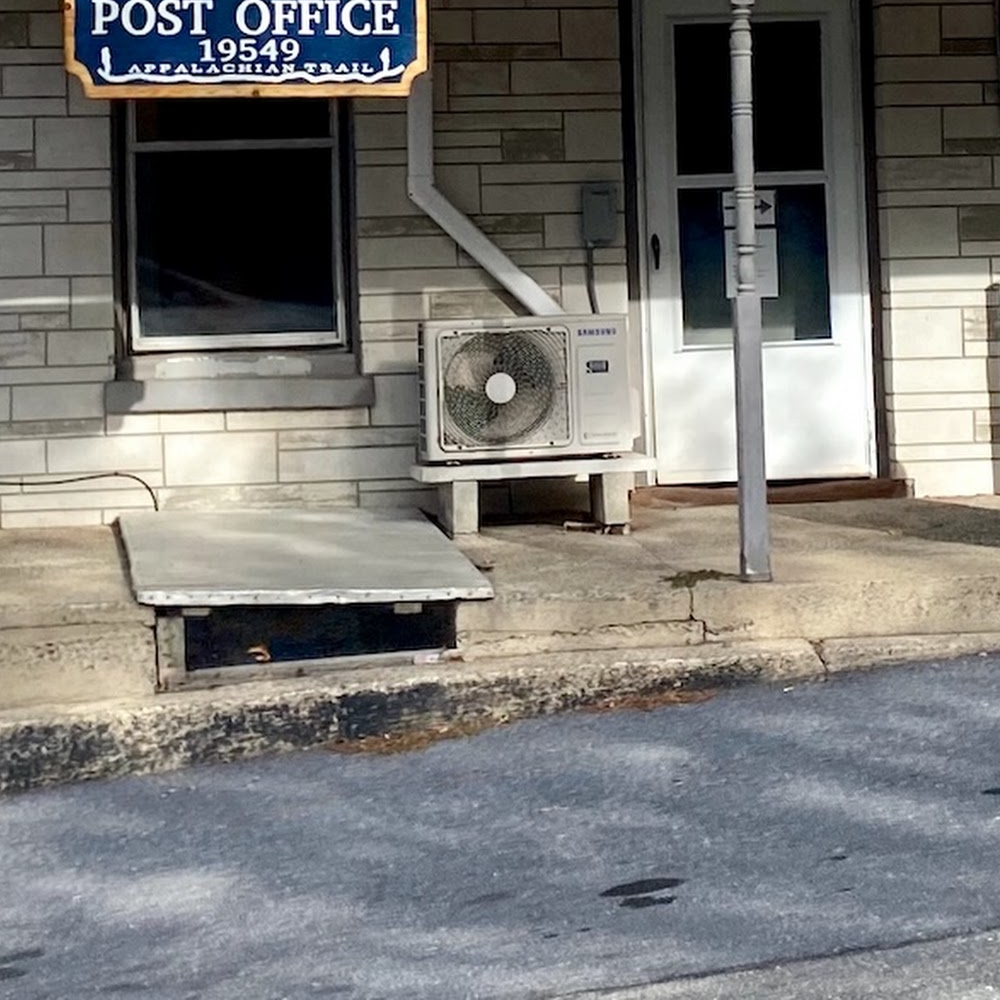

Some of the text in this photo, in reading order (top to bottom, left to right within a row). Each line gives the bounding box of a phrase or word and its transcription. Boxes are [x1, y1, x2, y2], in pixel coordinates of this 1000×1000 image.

[91, 0, 214, 36] POST
[199, 38, 301, 63] 19549
[127, 63, 375, 74] APPALACHIAN TRAIL
[577, 327, 617, 336] SAMSUNG
